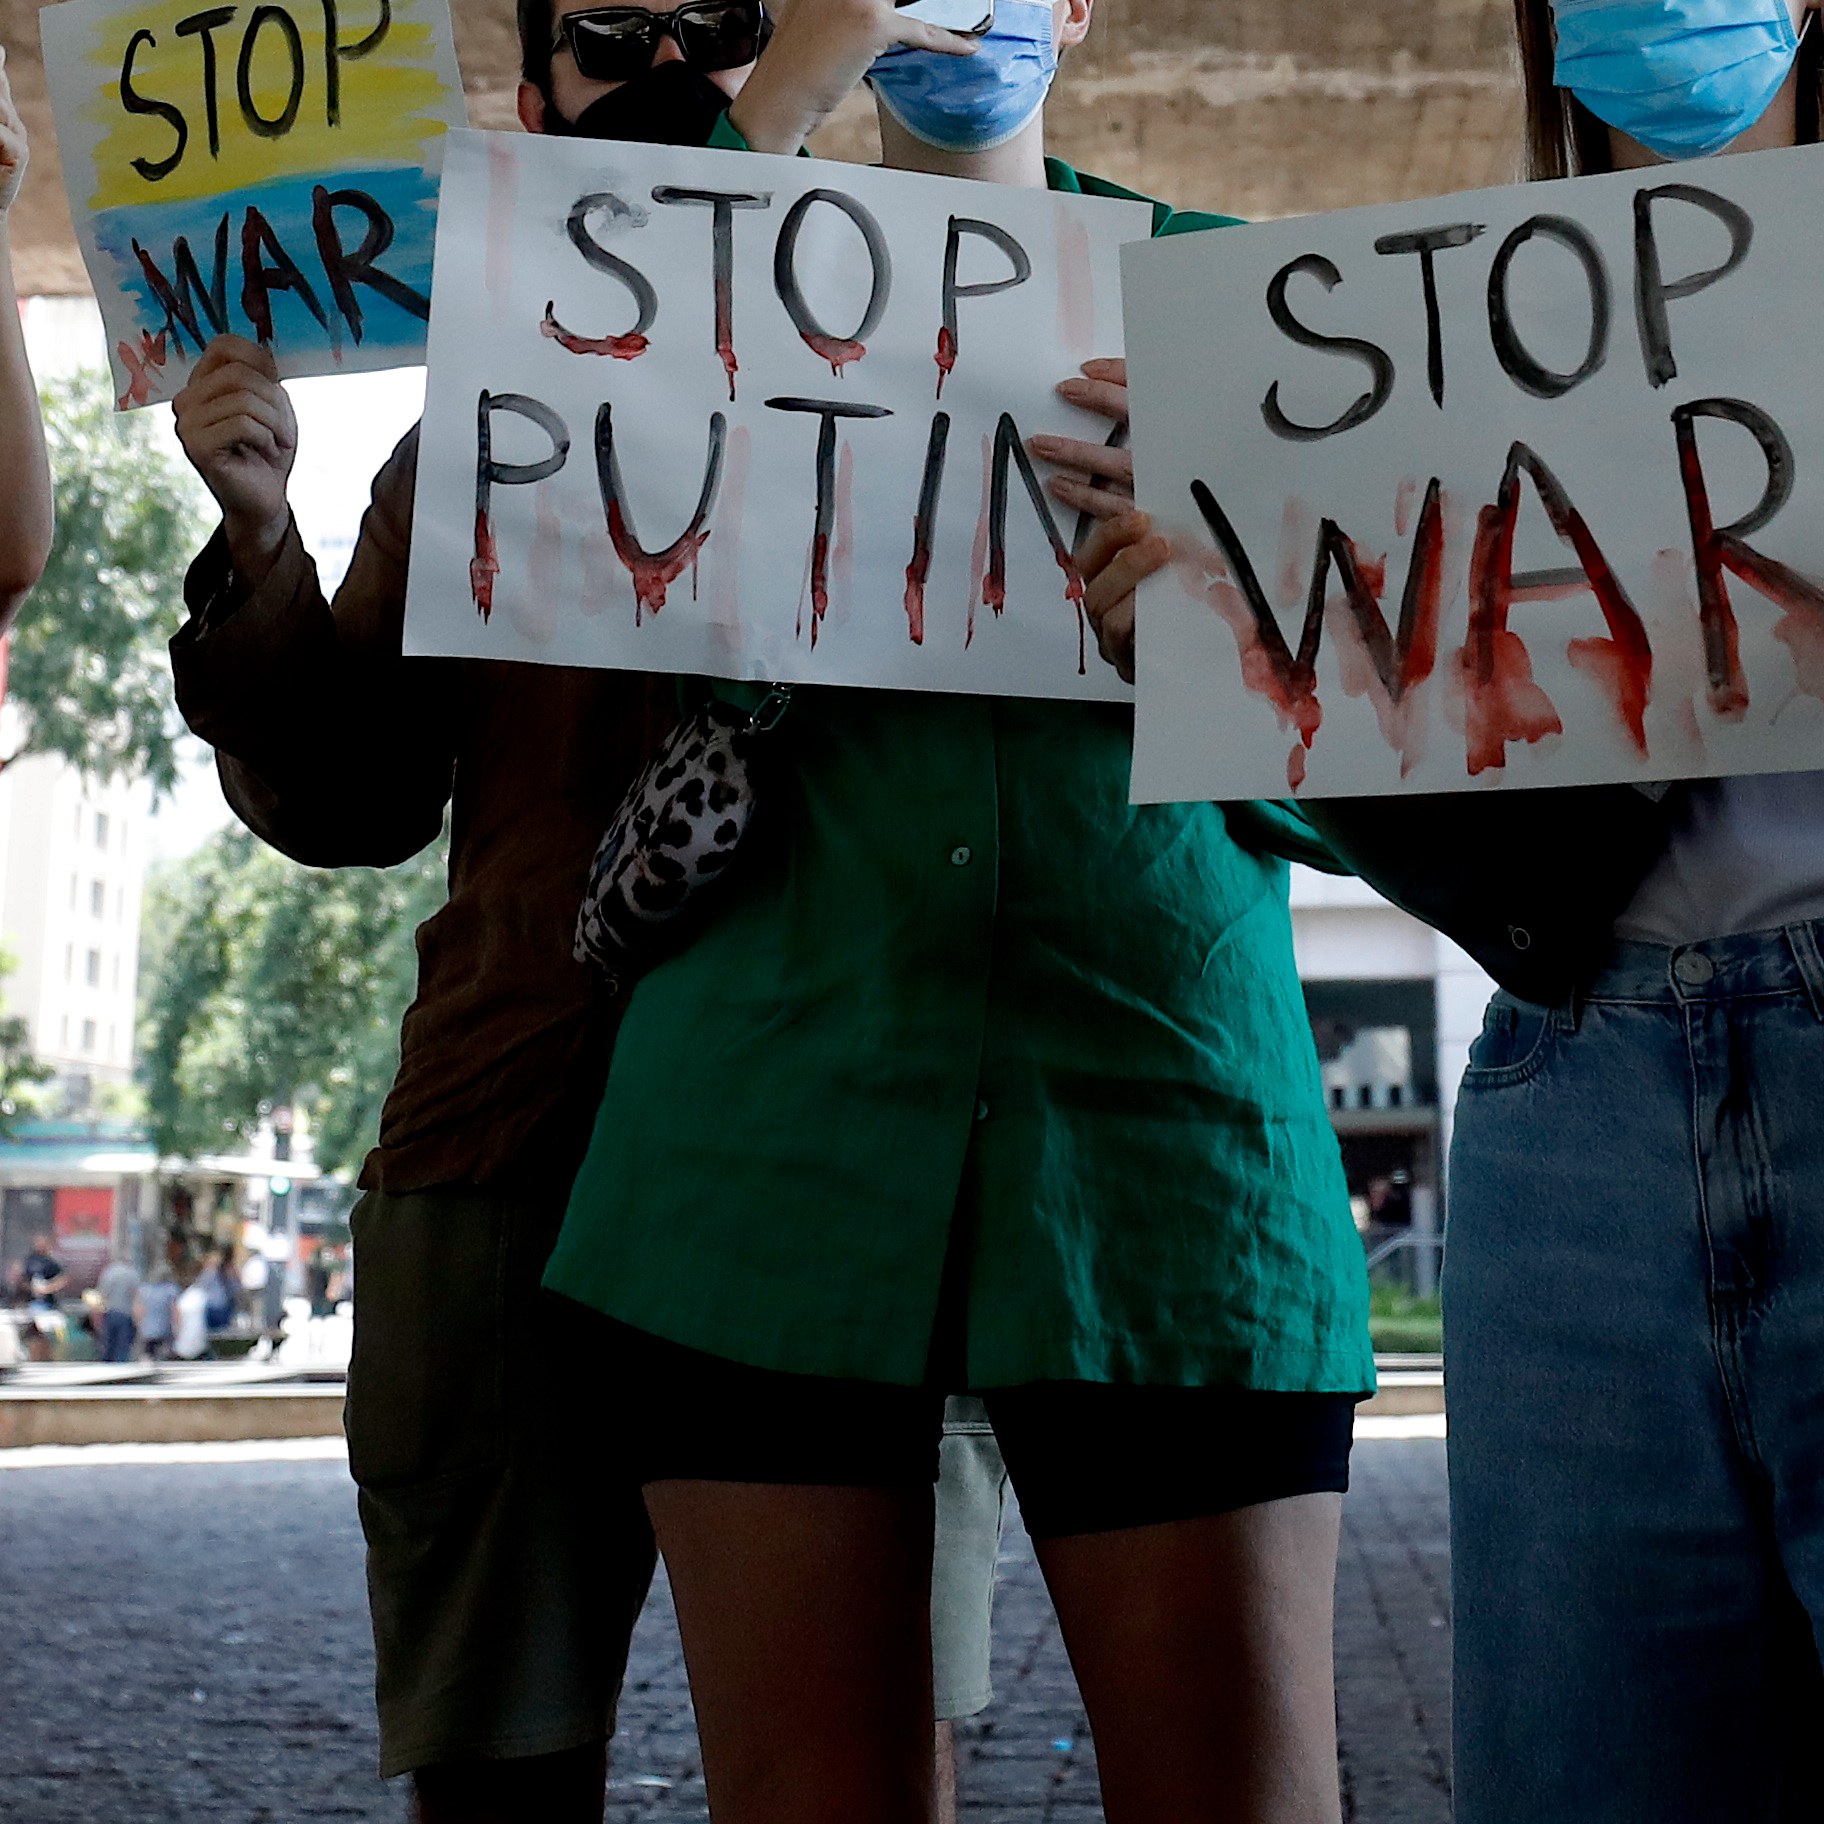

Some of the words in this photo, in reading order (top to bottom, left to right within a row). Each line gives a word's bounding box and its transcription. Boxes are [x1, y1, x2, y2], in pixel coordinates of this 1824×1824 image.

[131, 184, 430, 362] WAR
[541, 185, 1031, 392] STOP
[1262, 183, 1755, 442] STOP
